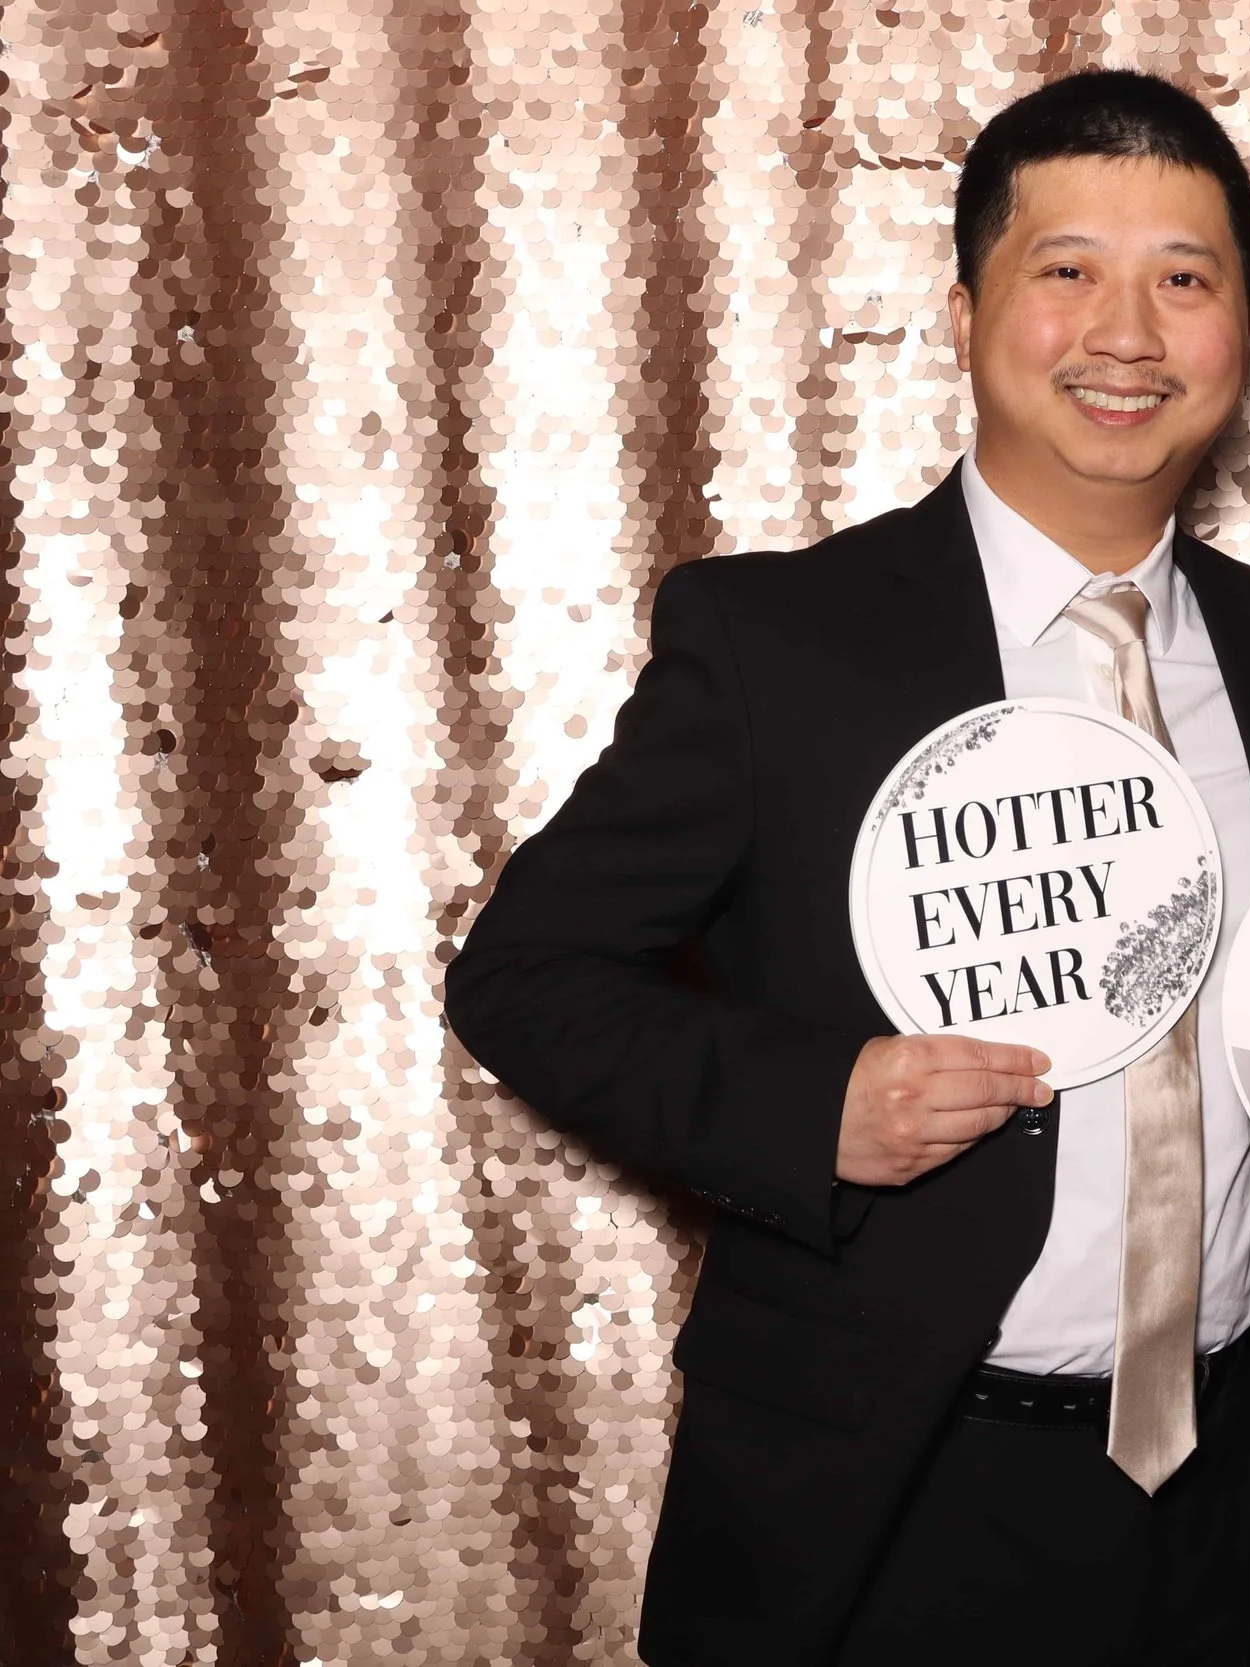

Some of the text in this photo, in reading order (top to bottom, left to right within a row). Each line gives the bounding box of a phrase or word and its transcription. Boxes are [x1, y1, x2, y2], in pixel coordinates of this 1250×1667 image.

[898, 776, 1163, 869] HOTTER
[909, 861, 1115, 951] EVERY
[920, 947, 1093, 1028] YEAR
